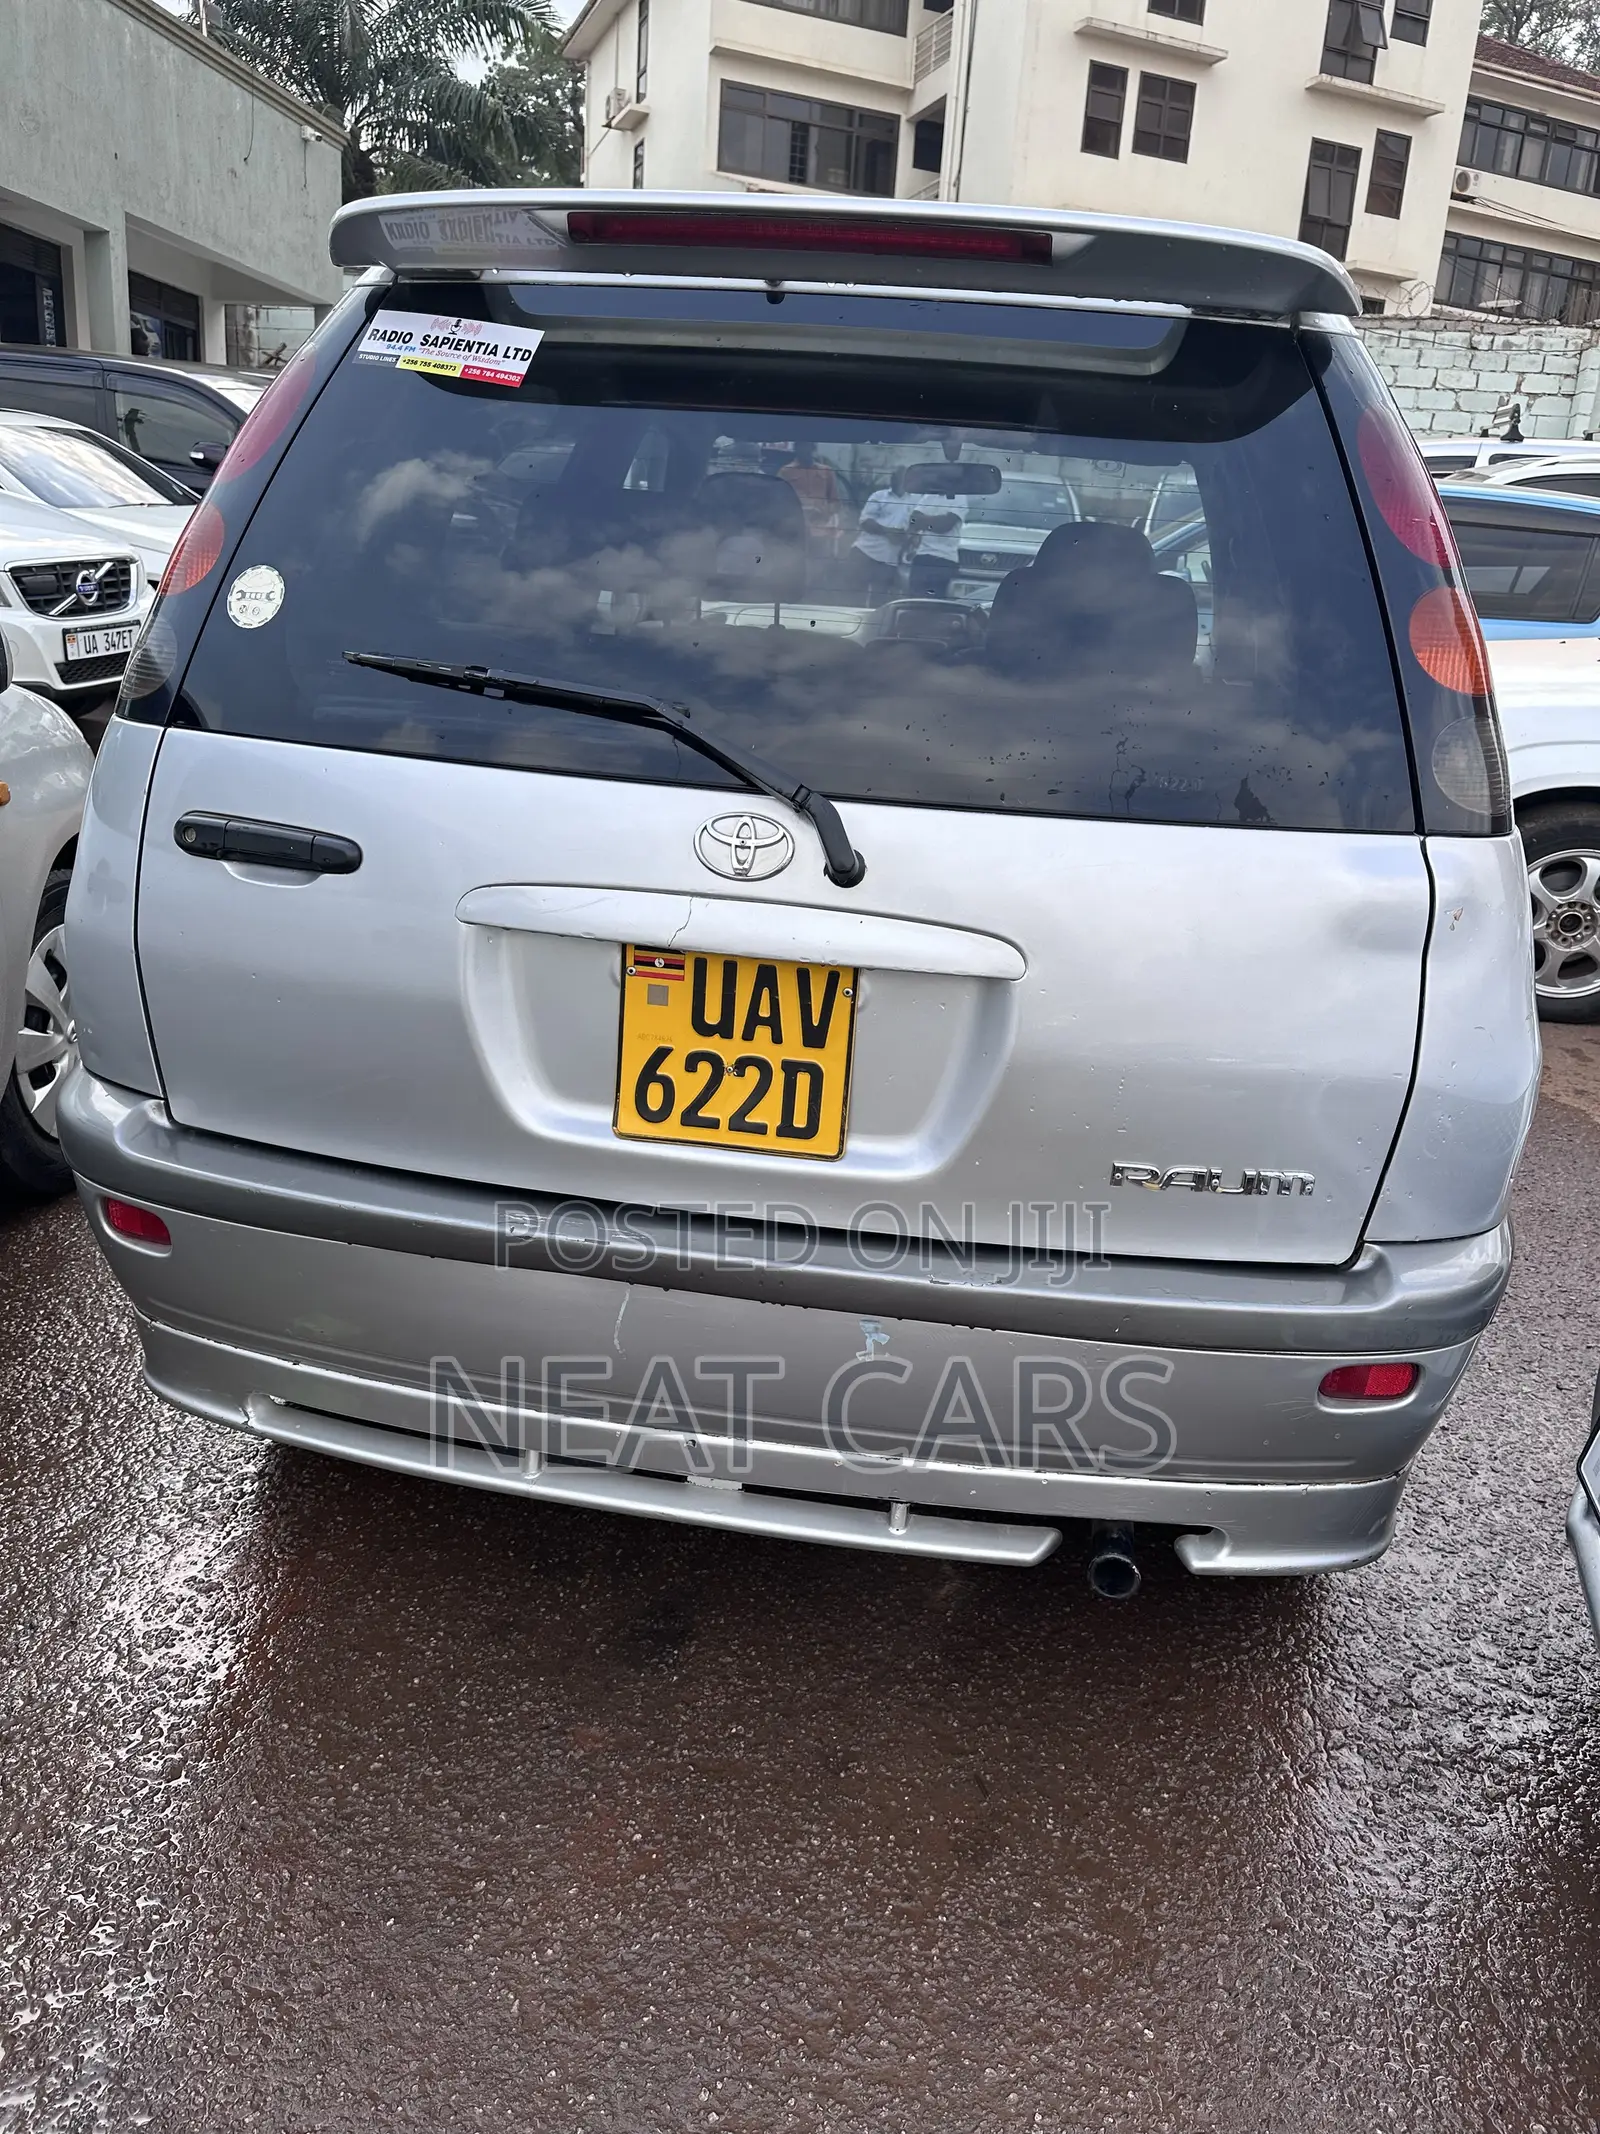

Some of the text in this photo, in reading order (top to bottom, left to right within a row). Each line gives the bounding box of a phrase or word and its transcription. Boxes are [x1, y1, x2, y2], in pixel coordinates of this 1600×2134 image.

[359, 353, 397, 363] STUDIO LINES
[367, 328, 532, 362] RADIO SAPIENTIA LTD
[386, 343, 416, 353] 94.4 FM
[436, 350, 461, 360] Source
[462, 354, 473, 362] of
[402, 358, 418, 366] +256
[83, 629, 133, 655] UA 347ET
[691, 957, 840, 1049] UAV
[634, 1045, 824, 1140] 622D
[1110, 1160, 1316, 1197] RAUM
